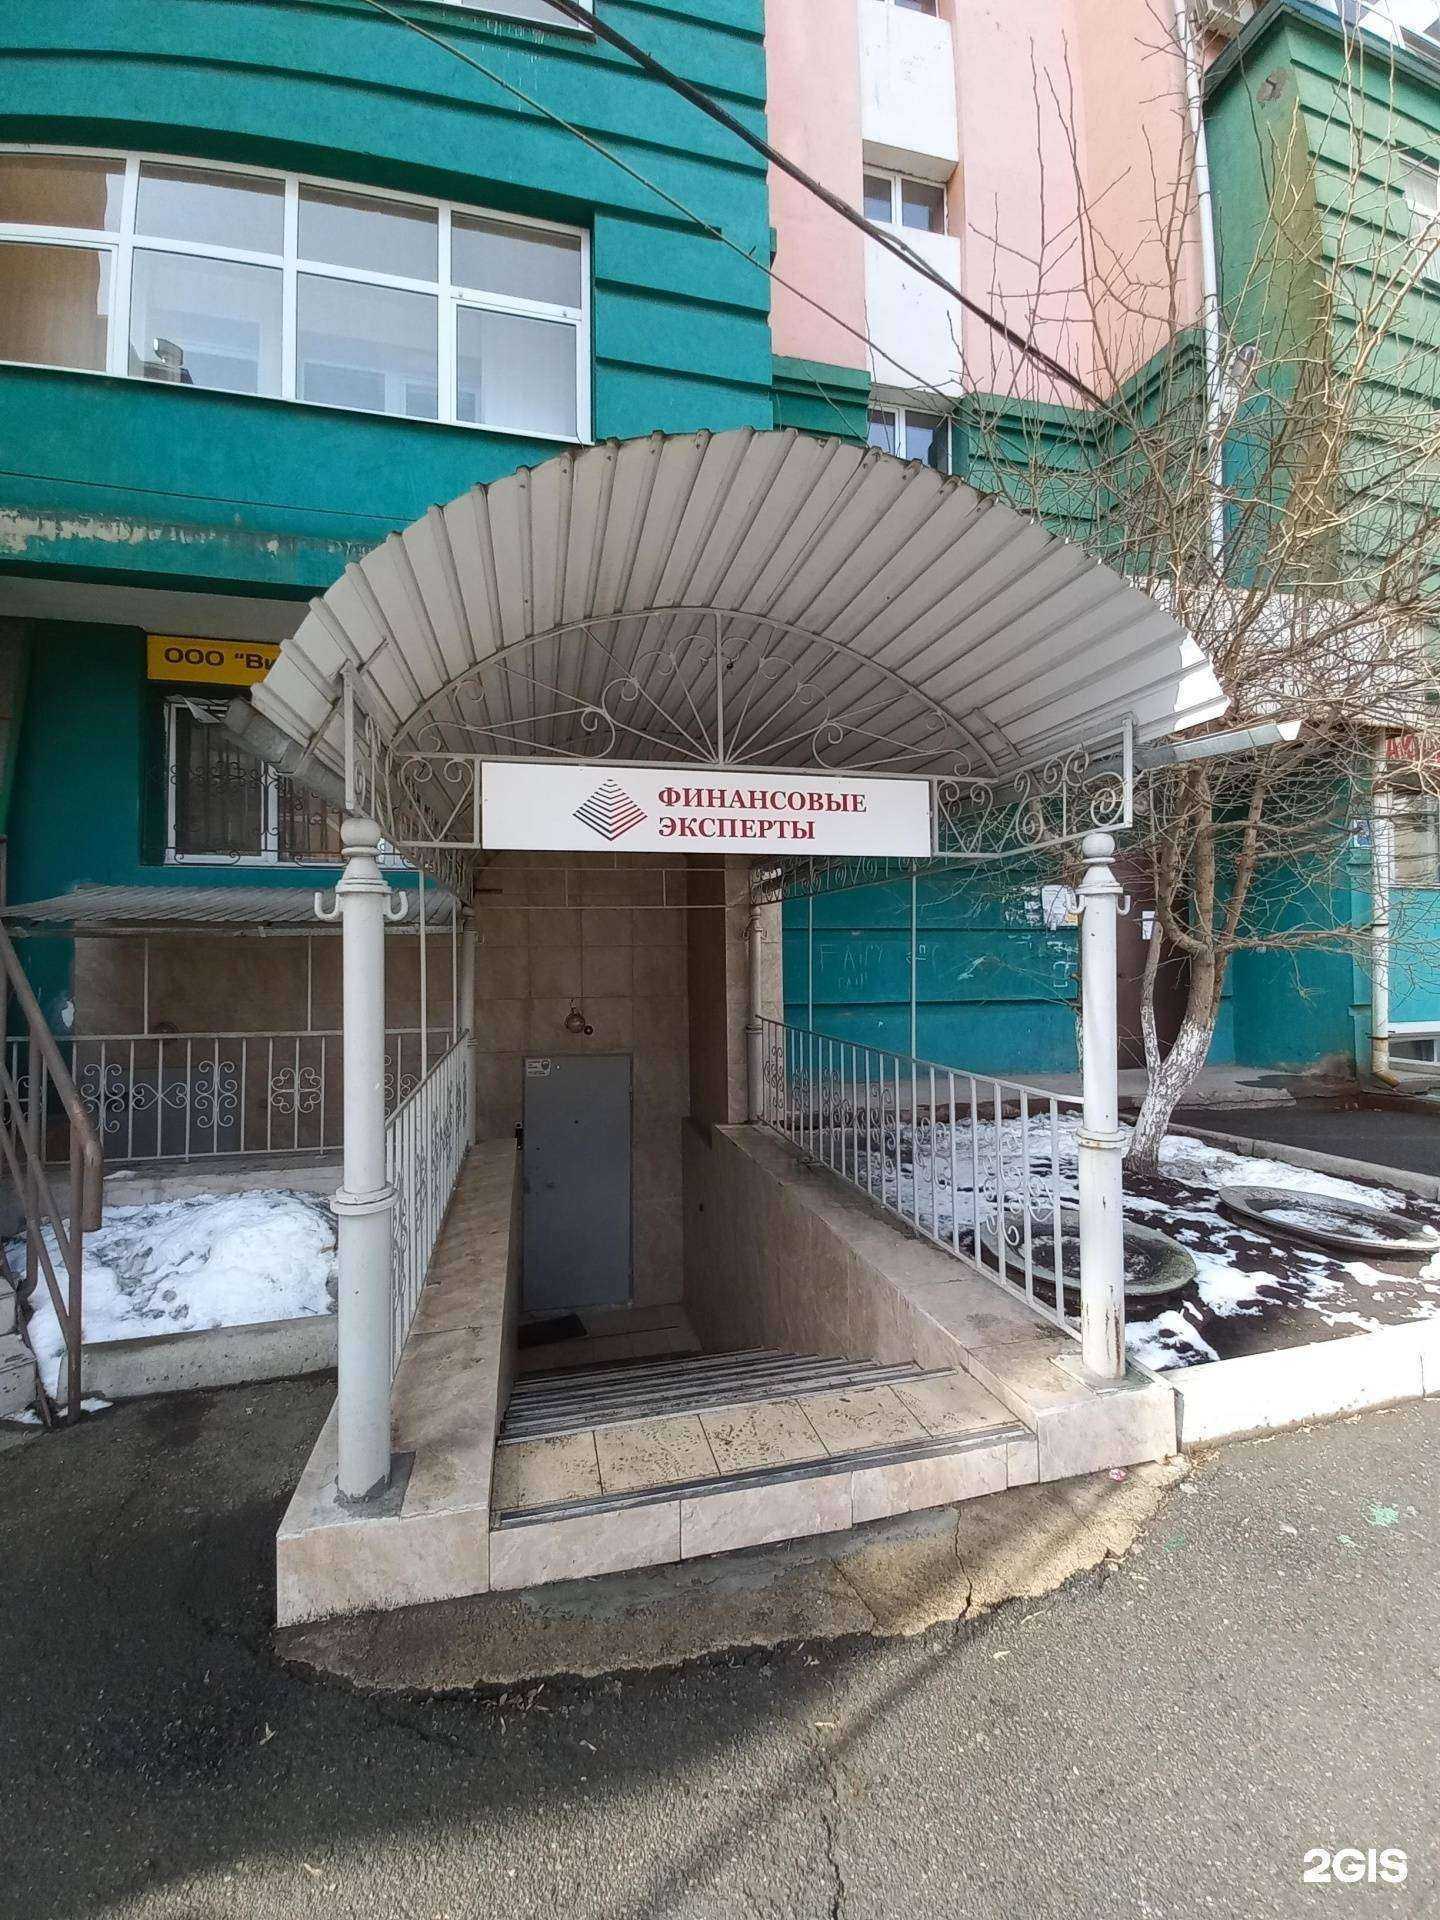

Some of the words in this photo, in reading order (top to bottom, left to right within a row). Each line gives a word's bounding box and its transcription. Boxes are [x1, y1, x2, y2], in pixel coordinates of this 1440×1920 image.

[164, 647, 225, 667] ООО
[658, 786, 867, 812] ФИНАНСОВЫЕ
[658, 816, 815, 839] ЭКСПЕРТЫ
